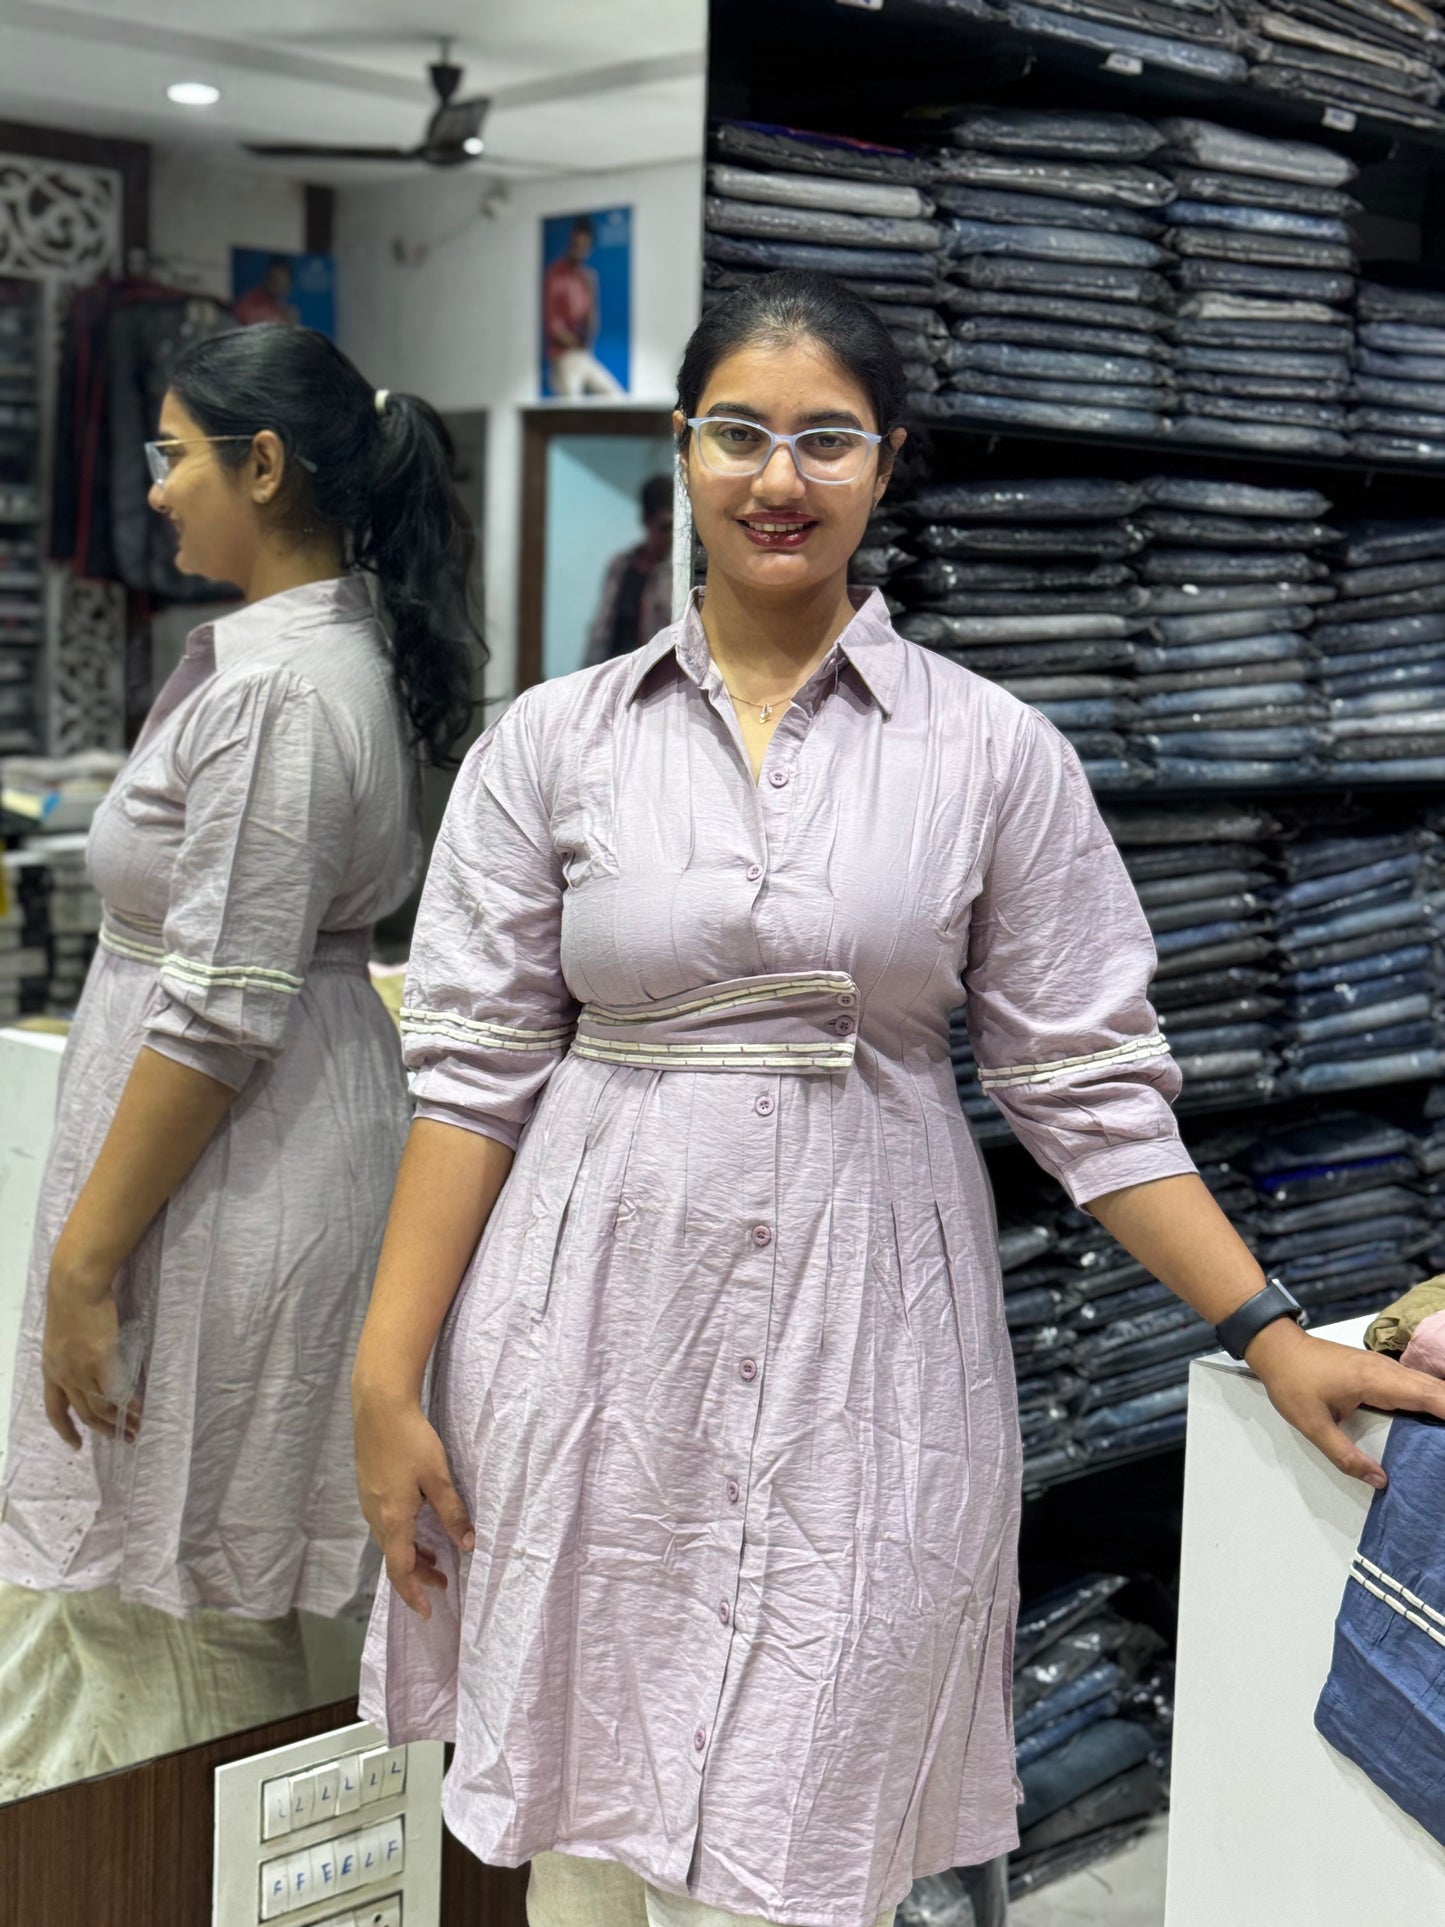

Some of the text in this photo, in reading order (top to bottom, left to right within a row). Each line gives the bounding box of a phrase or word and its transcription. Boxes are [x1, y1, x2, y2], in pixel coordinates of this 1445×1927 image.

[295, 1797, 304, 1813] L
[321, 1785, 331, 1801] L
[344, 1776, 355, 1791] L
[369, 1772, 378, 1787] L
[391, 1761, 402, 1775] L
[273, 1839, 399, 1896] F F E E L F
